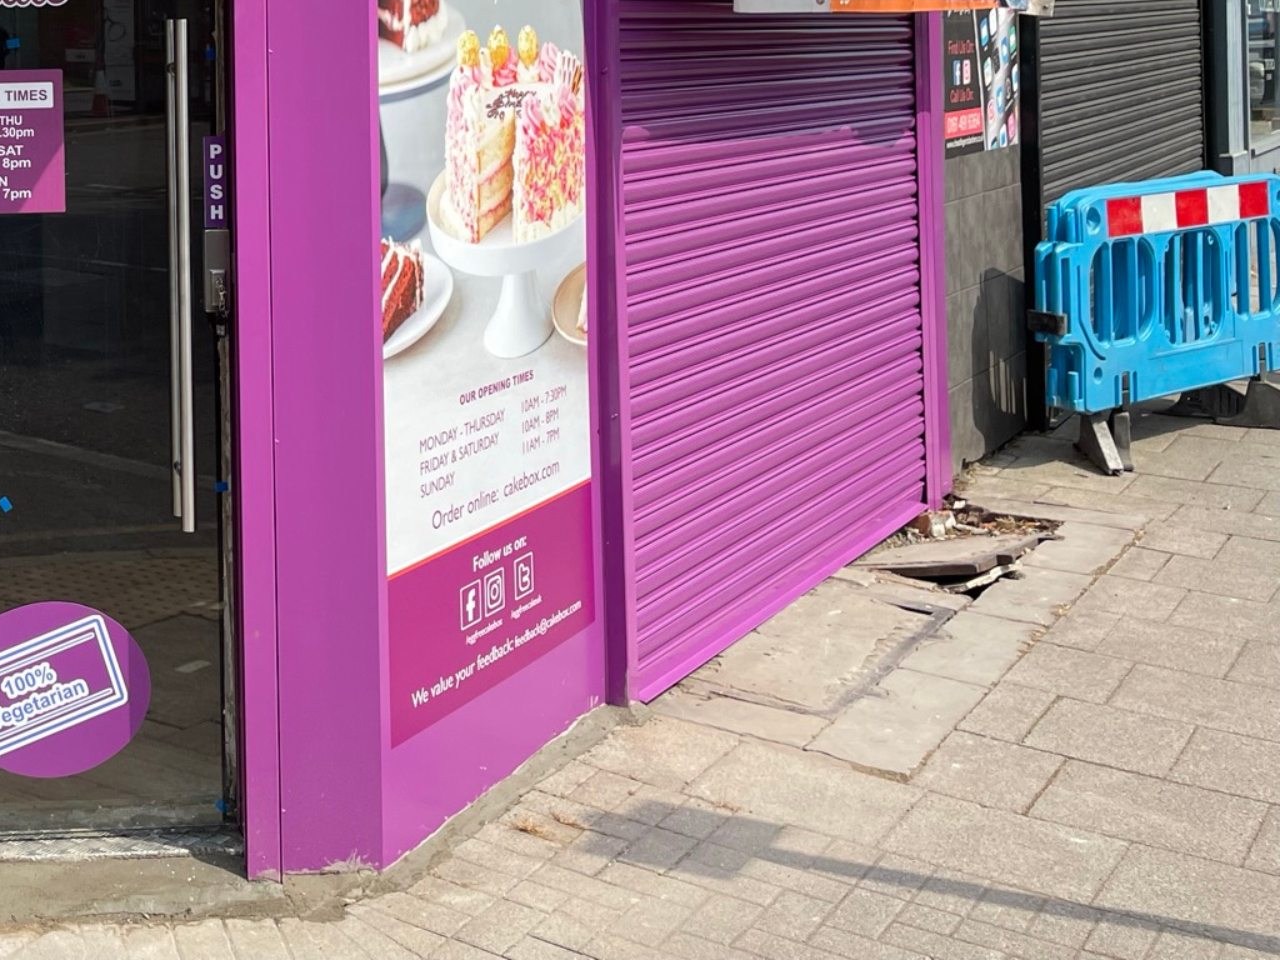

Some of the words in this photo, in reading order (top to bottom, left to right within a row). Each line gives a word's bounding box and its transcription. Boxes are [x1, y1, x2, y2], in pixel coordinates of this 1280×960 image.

[4, 88, 48, 102] TIMES
[0, 115, 23, 126] THU
[2, 158, 32, 171] 8pm
[2, 189, 32, 202] 7pm
[209, 144, 223, 220] PUSH
[459, 391, 476, 405] OUR
[478, 379, 510, 400] OPENING
[512, 370, 534, 387] TIMES
[521, 396, 539, 413] 10AM
[420, 427, 457, 453] MONDAY
[464, 409, 506, 437] THURSDAY
[521, 417, 540, 434] 10AM
[545, 408, 559, 424] 8PM
[420, 453, 449, 476] FRIDAY
[450, 449, 457, 464] &
[458, 431, 500, 462] SATURDAY
[521, 438, 541, 455] 11AM
[545, 428, 560, 445] 7PM
[420, 472, 455, 498] SUNDAY
[432, 503, 464, 530] Order
[467, 488, 500, 517] online:
[503, 461, 560, 498] cakebox.com
[472, 546, 502, 572] Follow
[503, 542, 513, 557] us
[514, 534, 527, 552] on:
[2, 665, 54, 696] 100%
[411, 690, 429, 709] We
[431, 674, 454, 699] value
[455, 663, 475, 690] your
[476, 639, 513, 670] feedback:
